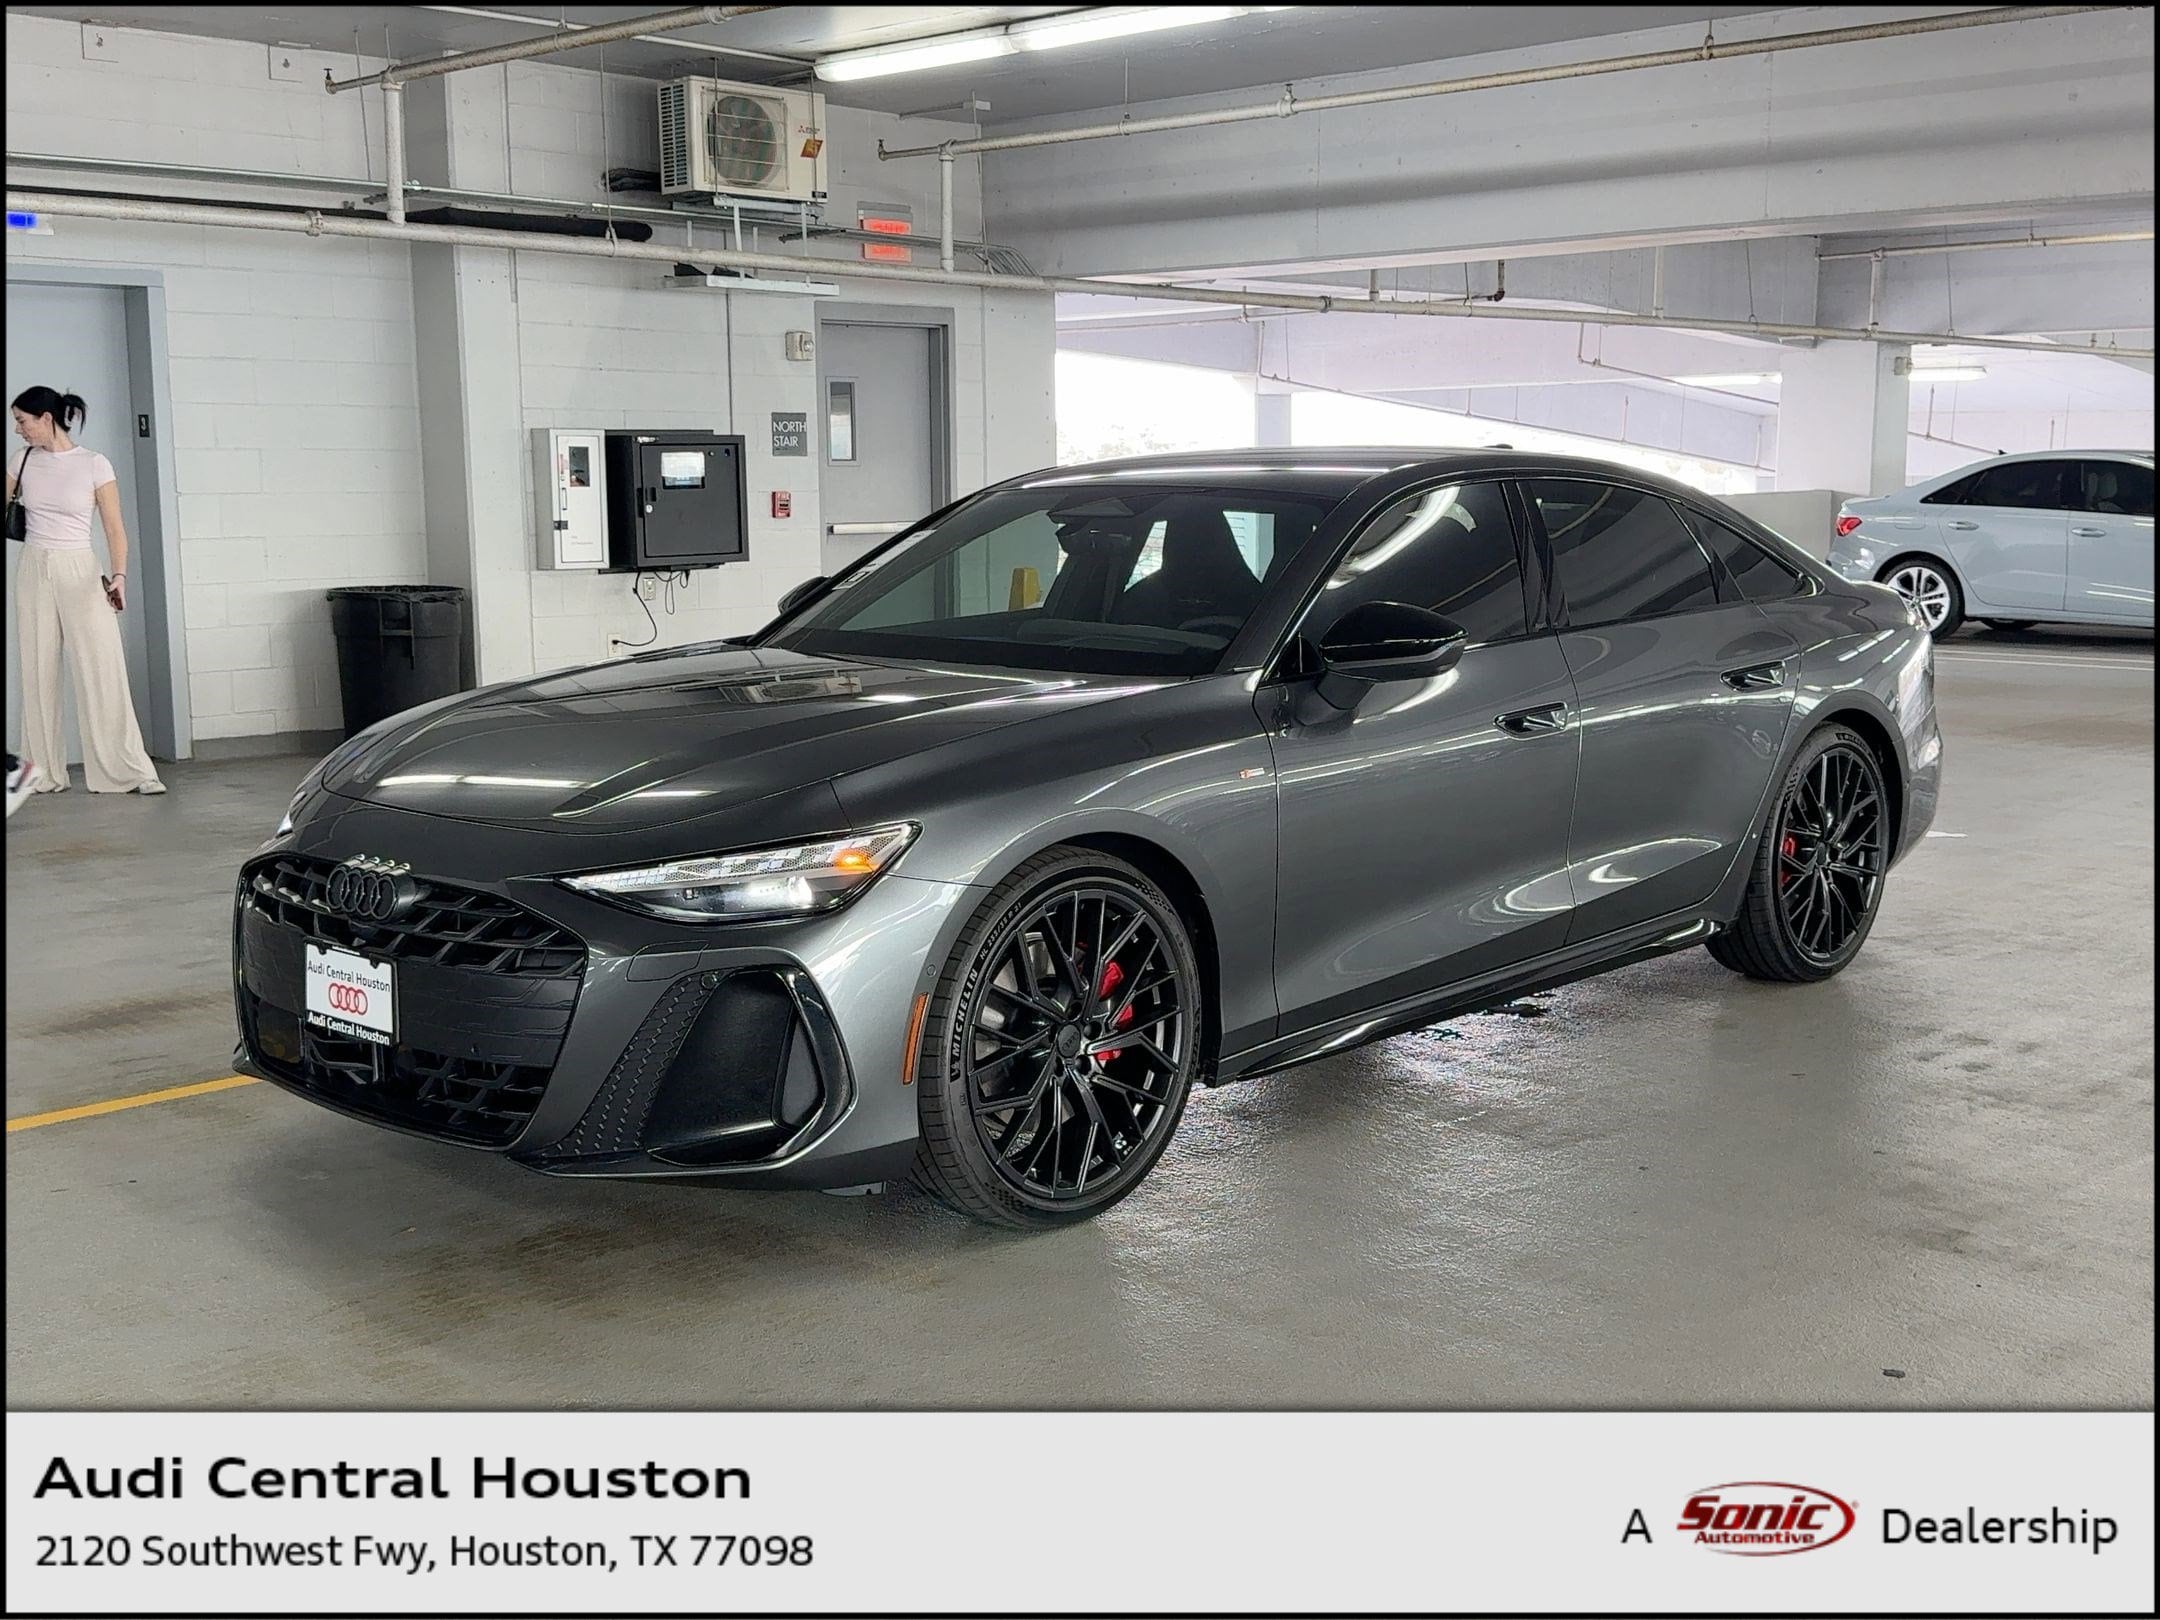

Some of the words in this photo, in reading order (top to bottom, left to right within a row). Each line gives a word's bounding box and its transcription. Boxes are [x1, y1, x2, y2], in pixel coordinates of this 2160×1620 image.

[773, 421, 807, 432] NORTH
[773, 435, 798, 447] STAIR
[308, 960, 325, 974] Audi
[326, 965, 354, 983] Central
[356, 973, 390, 992] Houston
[307, 1011, 326, 1027] Audi
[327, 1017, 355, 1036] Central
[356, 1025, 390, 1046] Houston
[952, 968, 978, 1057] MICHELIN
